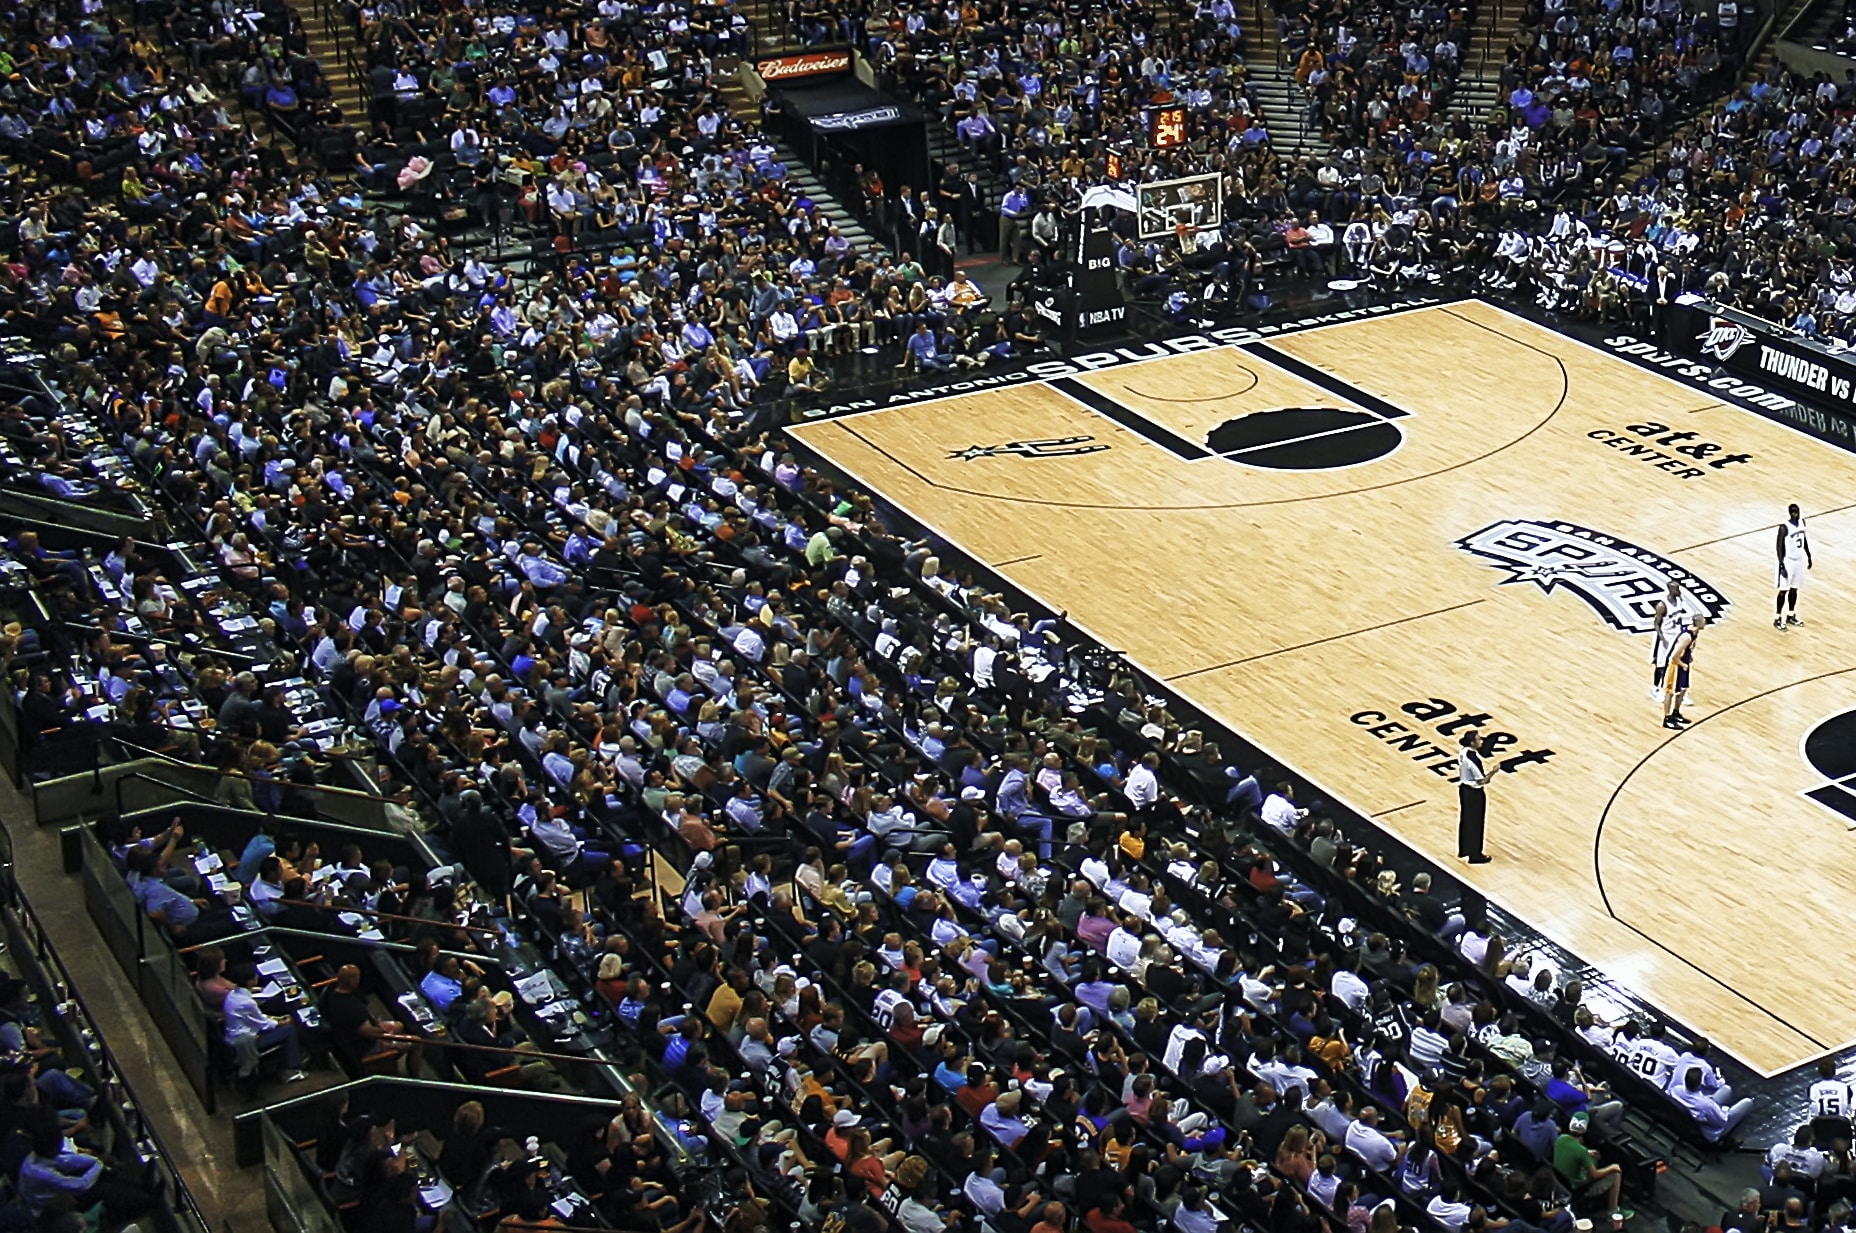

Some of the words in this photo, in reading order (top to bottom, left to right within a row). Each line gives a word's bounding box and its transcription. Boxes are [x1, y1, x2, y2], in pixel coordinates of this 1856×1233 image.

[758, 56, 849, 79] Budweiser
[1088, 256, 1111, 270] BIG
[1089, 310, 1110, 325] NBA
[1111, 307, 1125, 321] TV
[803, 399, 875, 418] SAN
[889, 371, 1029, 403] ANTONIO
[1026, 326, 1253, 379] SPURS
[1258, 297, 1440, 334] BASKETBALL
[1604, 335, 1797, 411] spurs.com
[1760, 345, 1828, 390] THUNDER
[1587, 429, 1706, 479] CENTER
[1626, 421, 1753, 470] at&t
[1556, 524, 1609, 546] SAN
[1622, 546, 1718, 604] ANTONIO
[1350, 710, 1460, 784] CENTE
[1401, 697, 1556, 774] at&t
[1632, 1052, 1657, 1075] 20
[1819, 1098, 1841, 1116] 15
